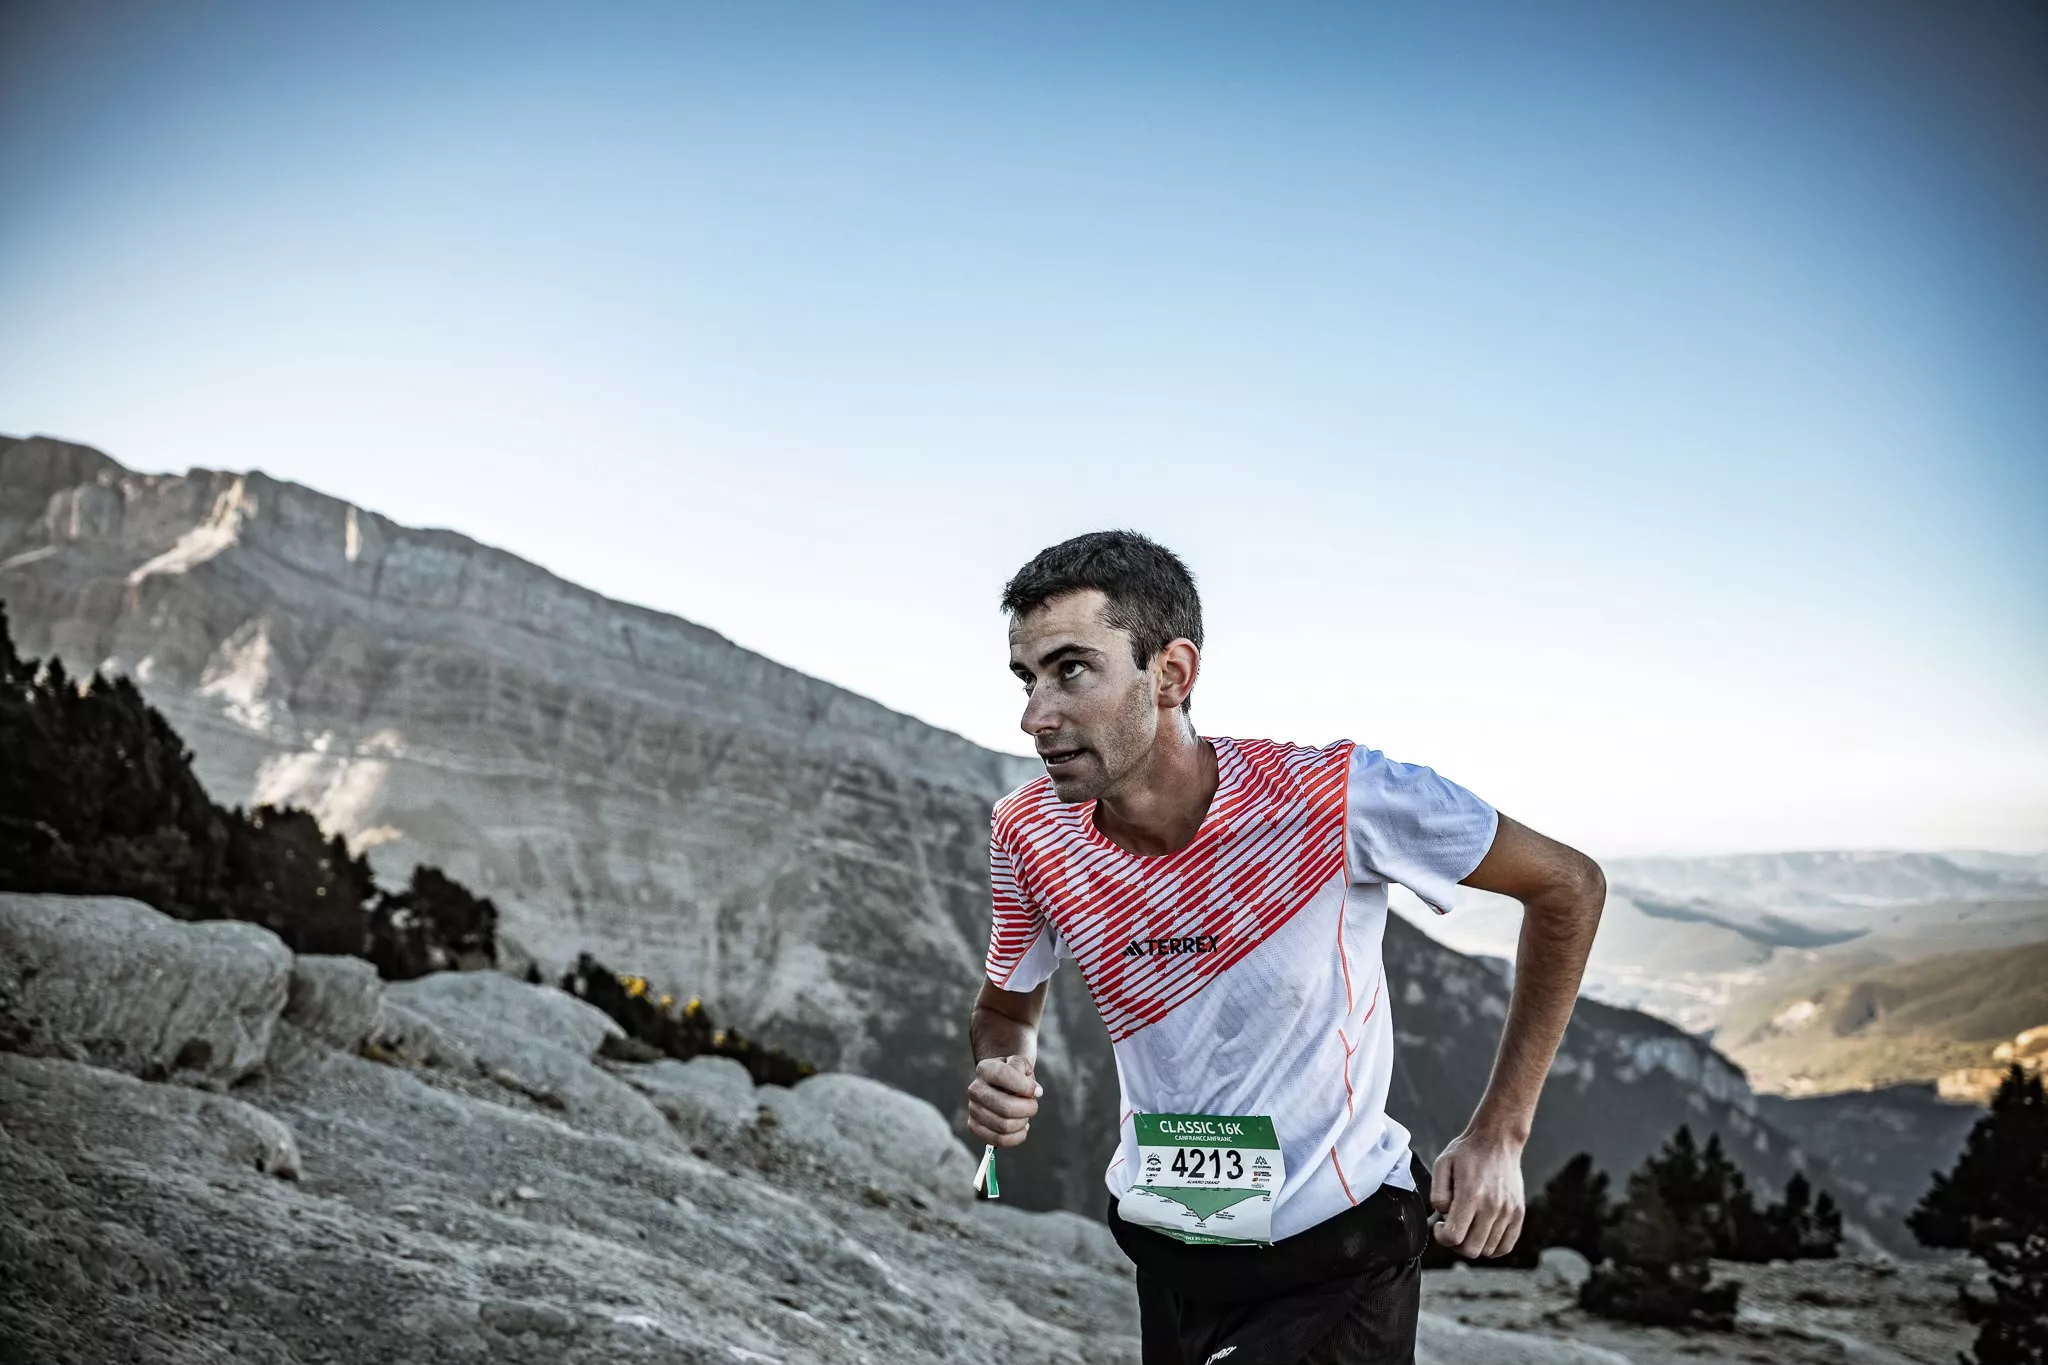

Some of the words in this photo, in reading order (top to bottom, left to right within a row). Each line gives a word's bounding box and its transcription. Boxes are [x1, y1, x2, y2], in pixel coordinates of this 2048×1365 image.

[1144, 935, 1219, 956] TERREX
[1160, 1120, 1215, 1134] CLASSIC
[1217, 1122, 1244, 1136] 16K
[1174, 1134, 1233, 1143] CANFRANCCANFRANC
[1170, 1148, 1244, 1180] 4213
